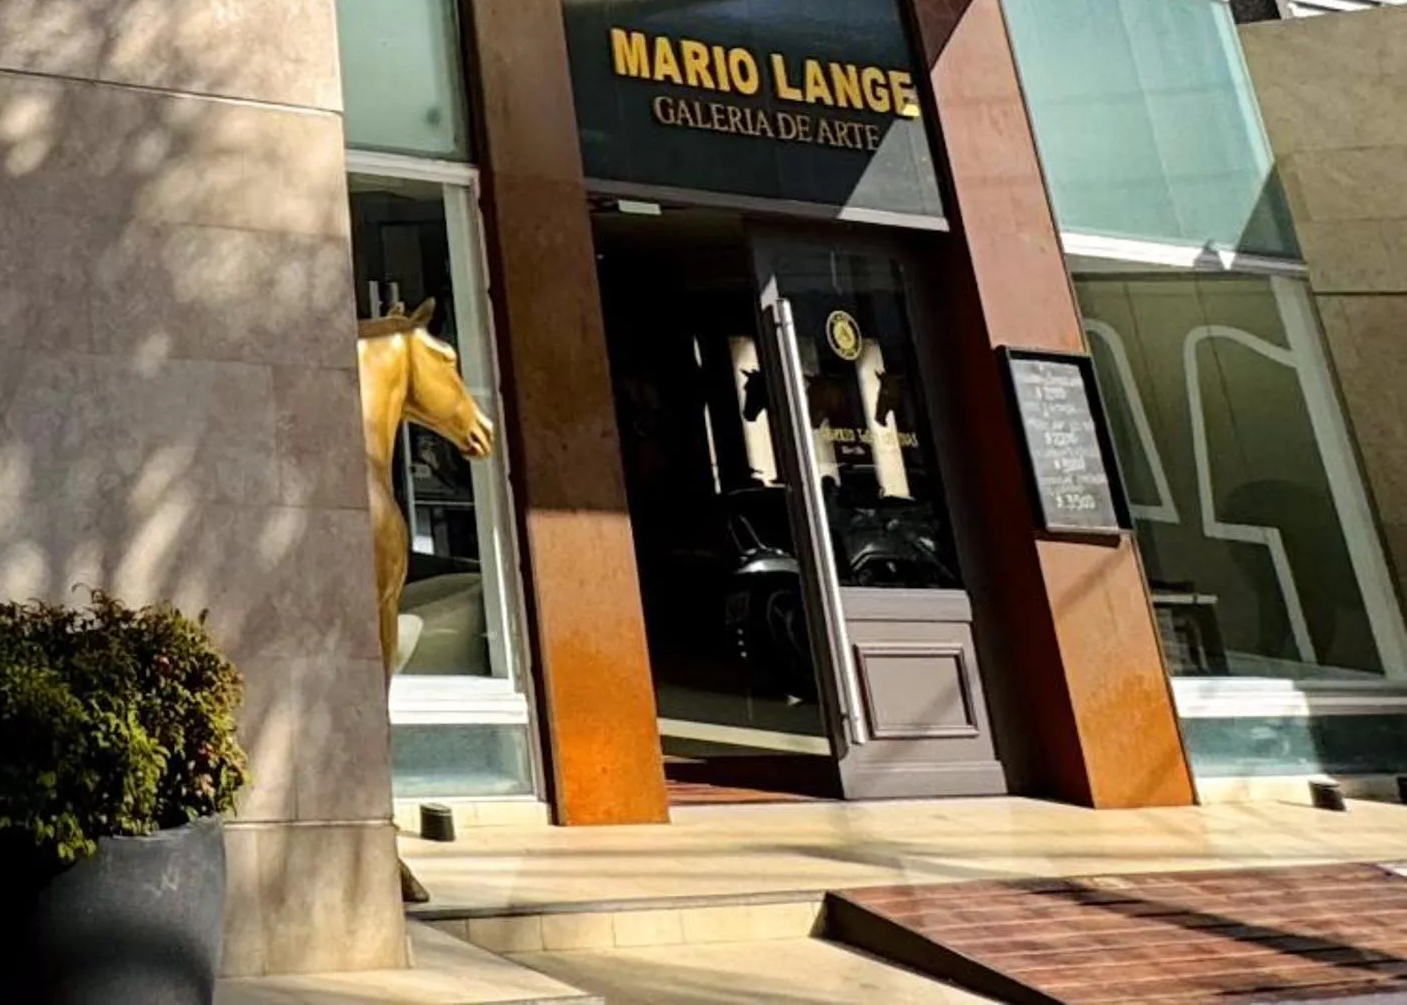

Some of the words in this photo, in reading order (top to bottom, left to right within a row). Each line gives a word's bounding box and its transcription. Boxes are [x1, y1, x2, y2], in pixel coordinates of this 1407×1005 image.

[610, 27, 760, 96] MARIO
[770, 53, 921, 118] LANGE
[654, 95, 778, 141] GALERIA
[777, 112, 813, 143] DE
[817, 120, 881, 151] ARTE
